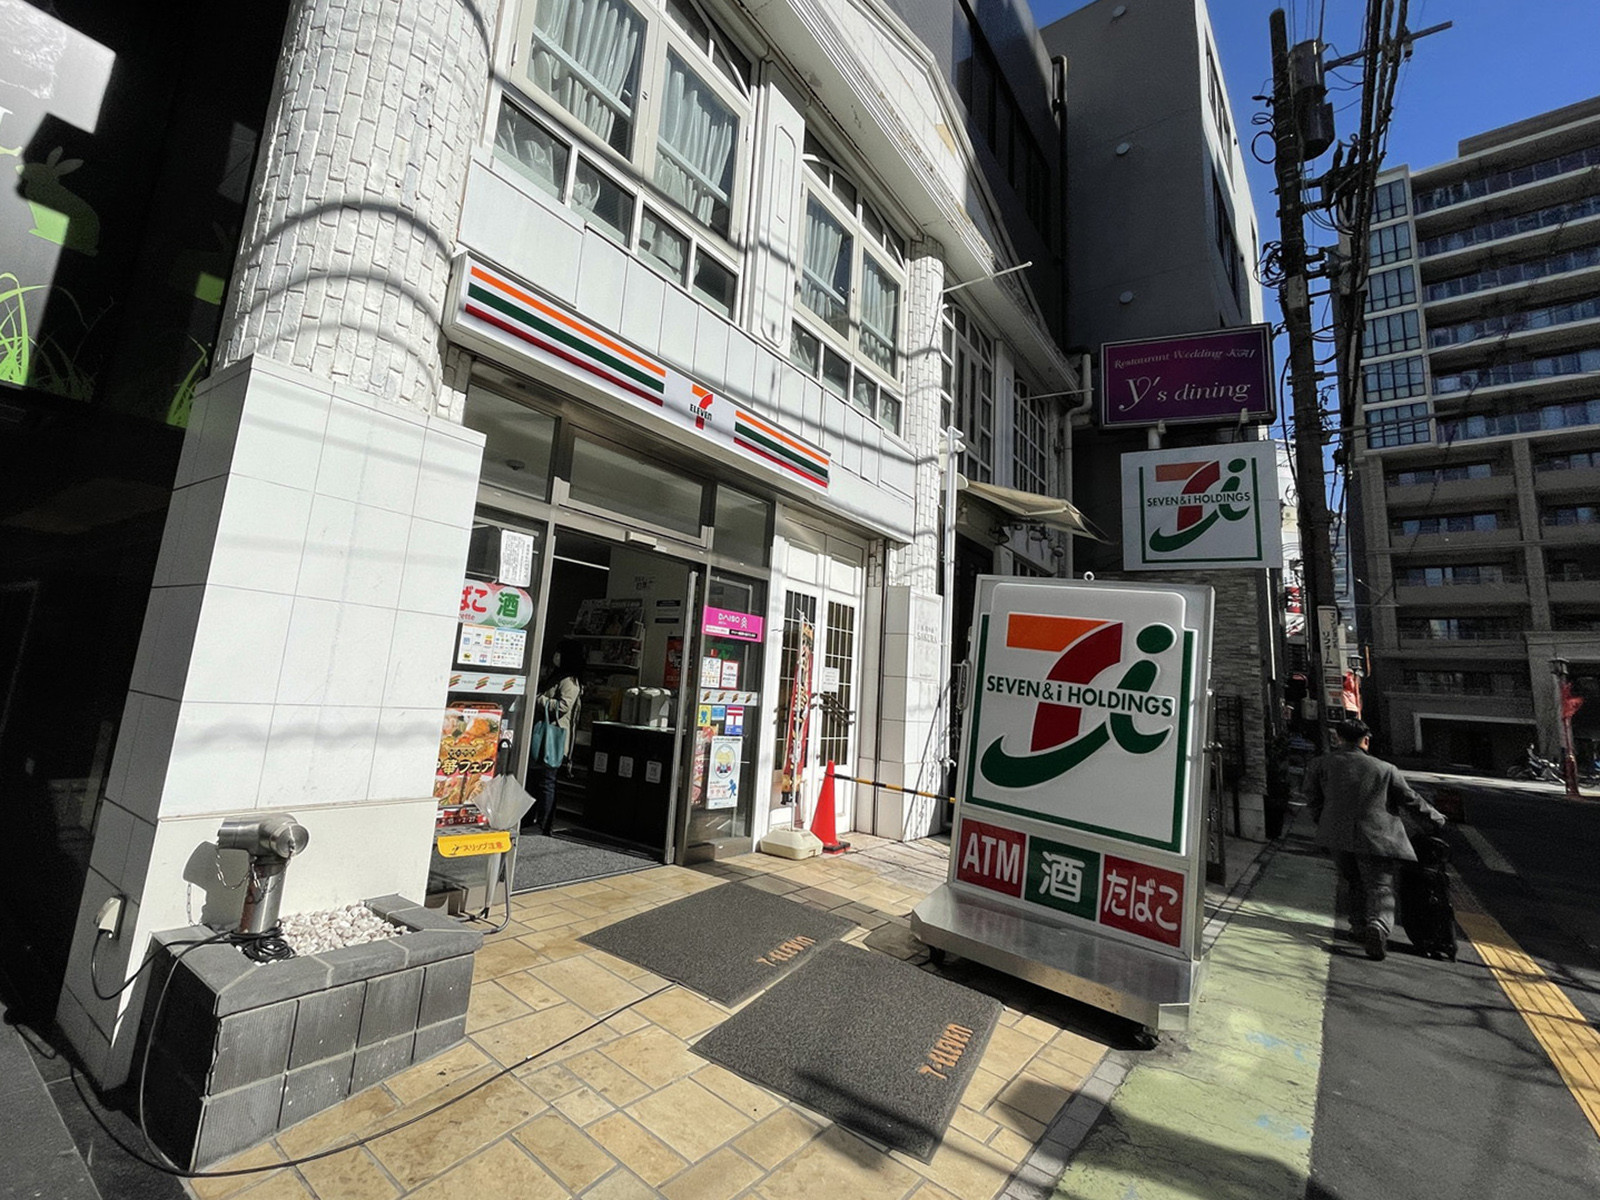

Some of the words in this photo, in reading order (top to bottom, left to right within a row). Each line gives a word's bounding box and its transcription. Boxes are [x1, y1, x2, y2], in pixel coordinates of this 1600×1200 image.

[1173, 348, 1223, 361] Wedding
[1174, 382, 1251, 402] dining
[1194, 492, 1251, 504] HOLDINGS
[497, 592, 520, 618] 酒
[1068, 685, 1173, 717] HOLDINGS
[962, 832, 1021, 884] ATM
[1038, 851, 1086, 903] 酒
[1103, 869, 1178, 931] たばこ
